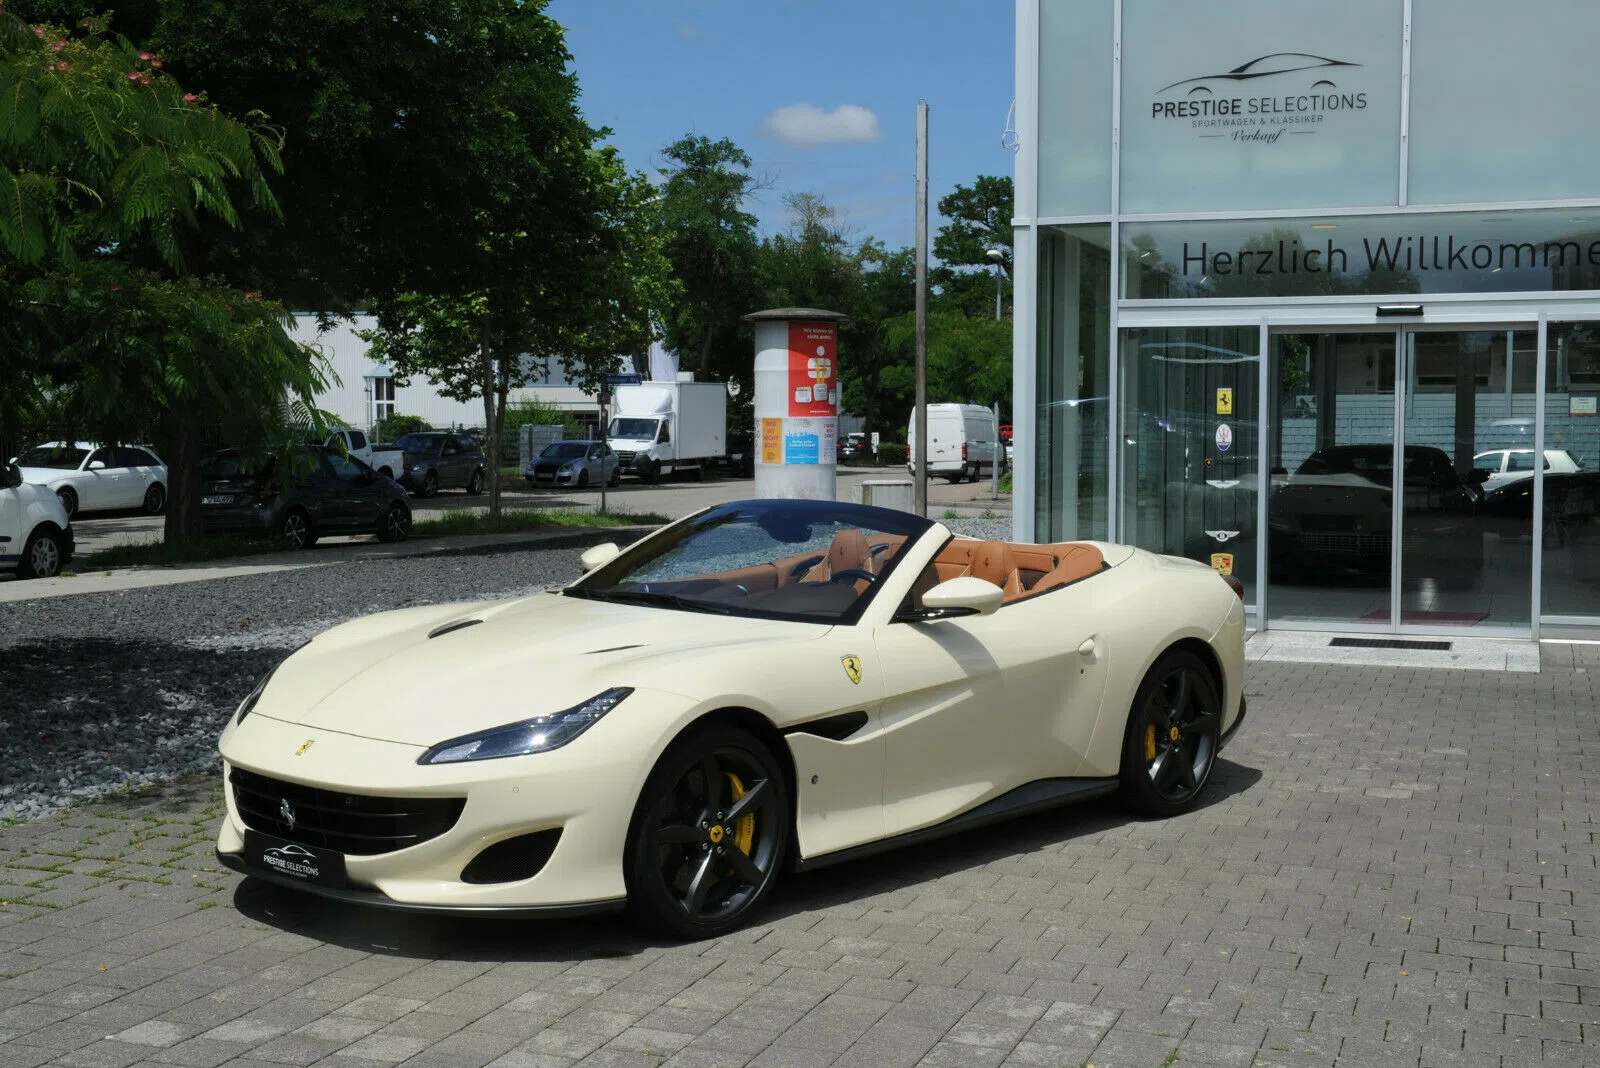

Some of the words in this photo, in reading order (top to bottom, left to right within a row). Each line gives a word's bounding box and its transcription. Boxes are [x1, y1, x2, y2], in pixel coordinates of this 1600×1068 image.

[1152, 98, 1242, 119] PRESTIGE
[1248, 93, 1367, 114] SELECTIONS
[1191, 117, 1256, 128] SPORTWAGEN
[1270, 115, 1324, 125] KLASSIKER
[1231, 128, 1286, 144] Verkauf
[1182, 238, 1347, 276] Herzlich
[263, 854, 286, 869] PRESTIGE
[286, 861, 320, 876] SELECTIONS
